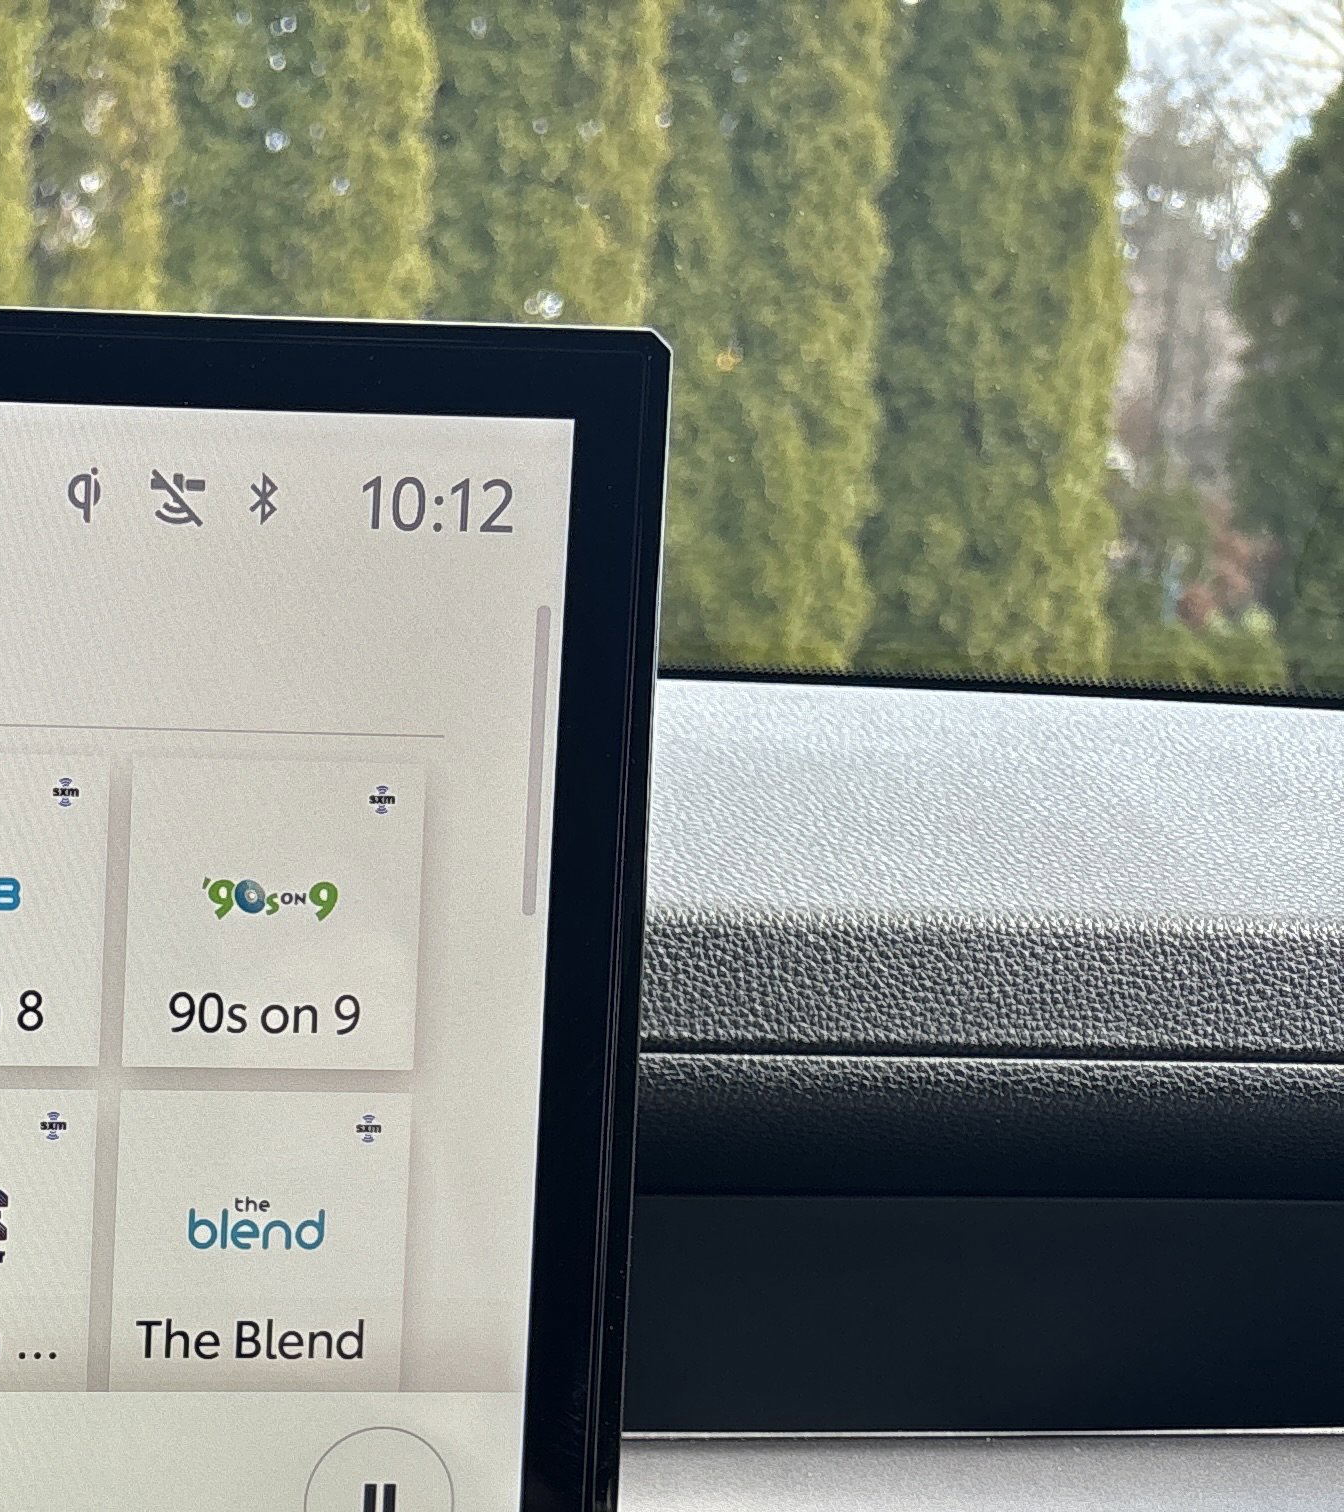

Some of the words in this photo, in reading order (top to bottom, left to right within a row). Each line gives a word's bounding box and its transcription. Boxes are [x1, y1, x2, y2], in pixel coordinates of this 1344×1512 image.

[363, 476, 513, 533] 10:12
[52, 785, 80, 798] sxm
[368, 793, 396, 805] sxm
[17, 990, 43, 1031] 8
[169, 992, 247, 1033] 90s
[261, 1005, 317, 1034] on
[335, 995, 360, 1035] 9
[39, 1120, 67, 1132] sxm
[355, 1122, 382, 1134] sxm
[234, 1196, 271, 1212] the
[188, 1208, 326, 1250] blend
[136, 1319, 220, 1359] The
[236, 1319, 364, 1359] Blend
